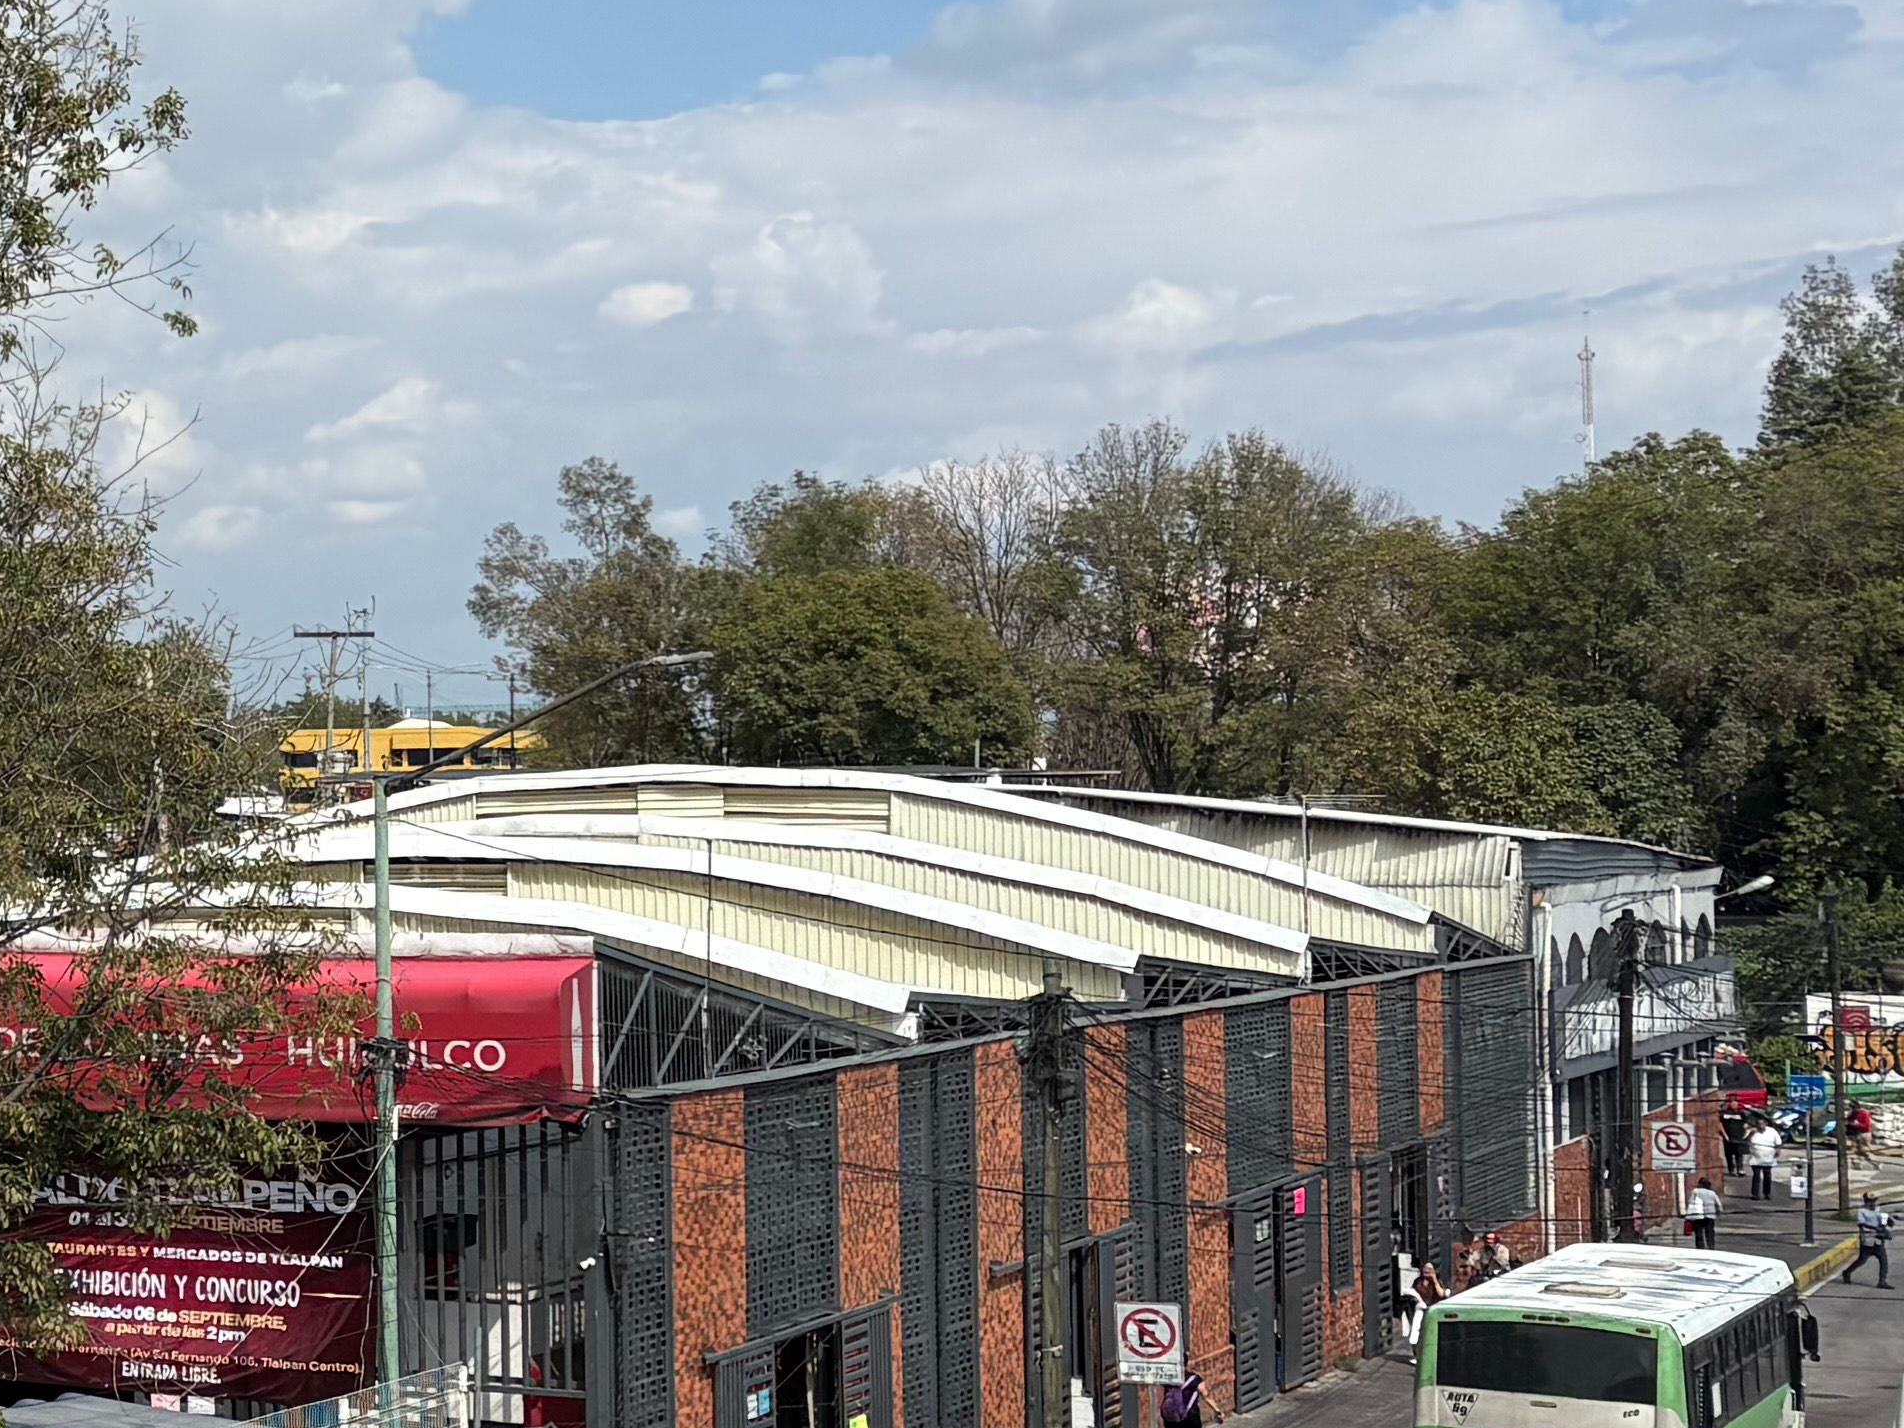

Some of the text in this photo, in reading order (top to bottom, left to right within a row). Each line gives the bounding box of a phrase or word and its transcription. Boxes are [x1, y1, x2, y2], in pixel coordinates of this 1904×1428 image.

[140, 1245, 151, 1257] Y
[153, 1246, 243, 1264] MERCADOS
[245, 1251, 268, 1264] DE
[271, 1252, 343, 1270] TLALPAN
[173, 1274, 188, 1300] Y
[195, 1276, 301, 1308] CONCURSO
[68, 1300, 288, 1332] Sábado 06 de SEPTIEMBRE,
[104, 1322, 245, 1344] a partir de las 2 pm
[171, 1350, 229, 1365] Fernando
[261, 1357, 307, 1371] Tlalpan
[122, 1361, 222, 1384] ENTRADA LIBRE.
[1622, 1408, 1640, 1419] ECO
